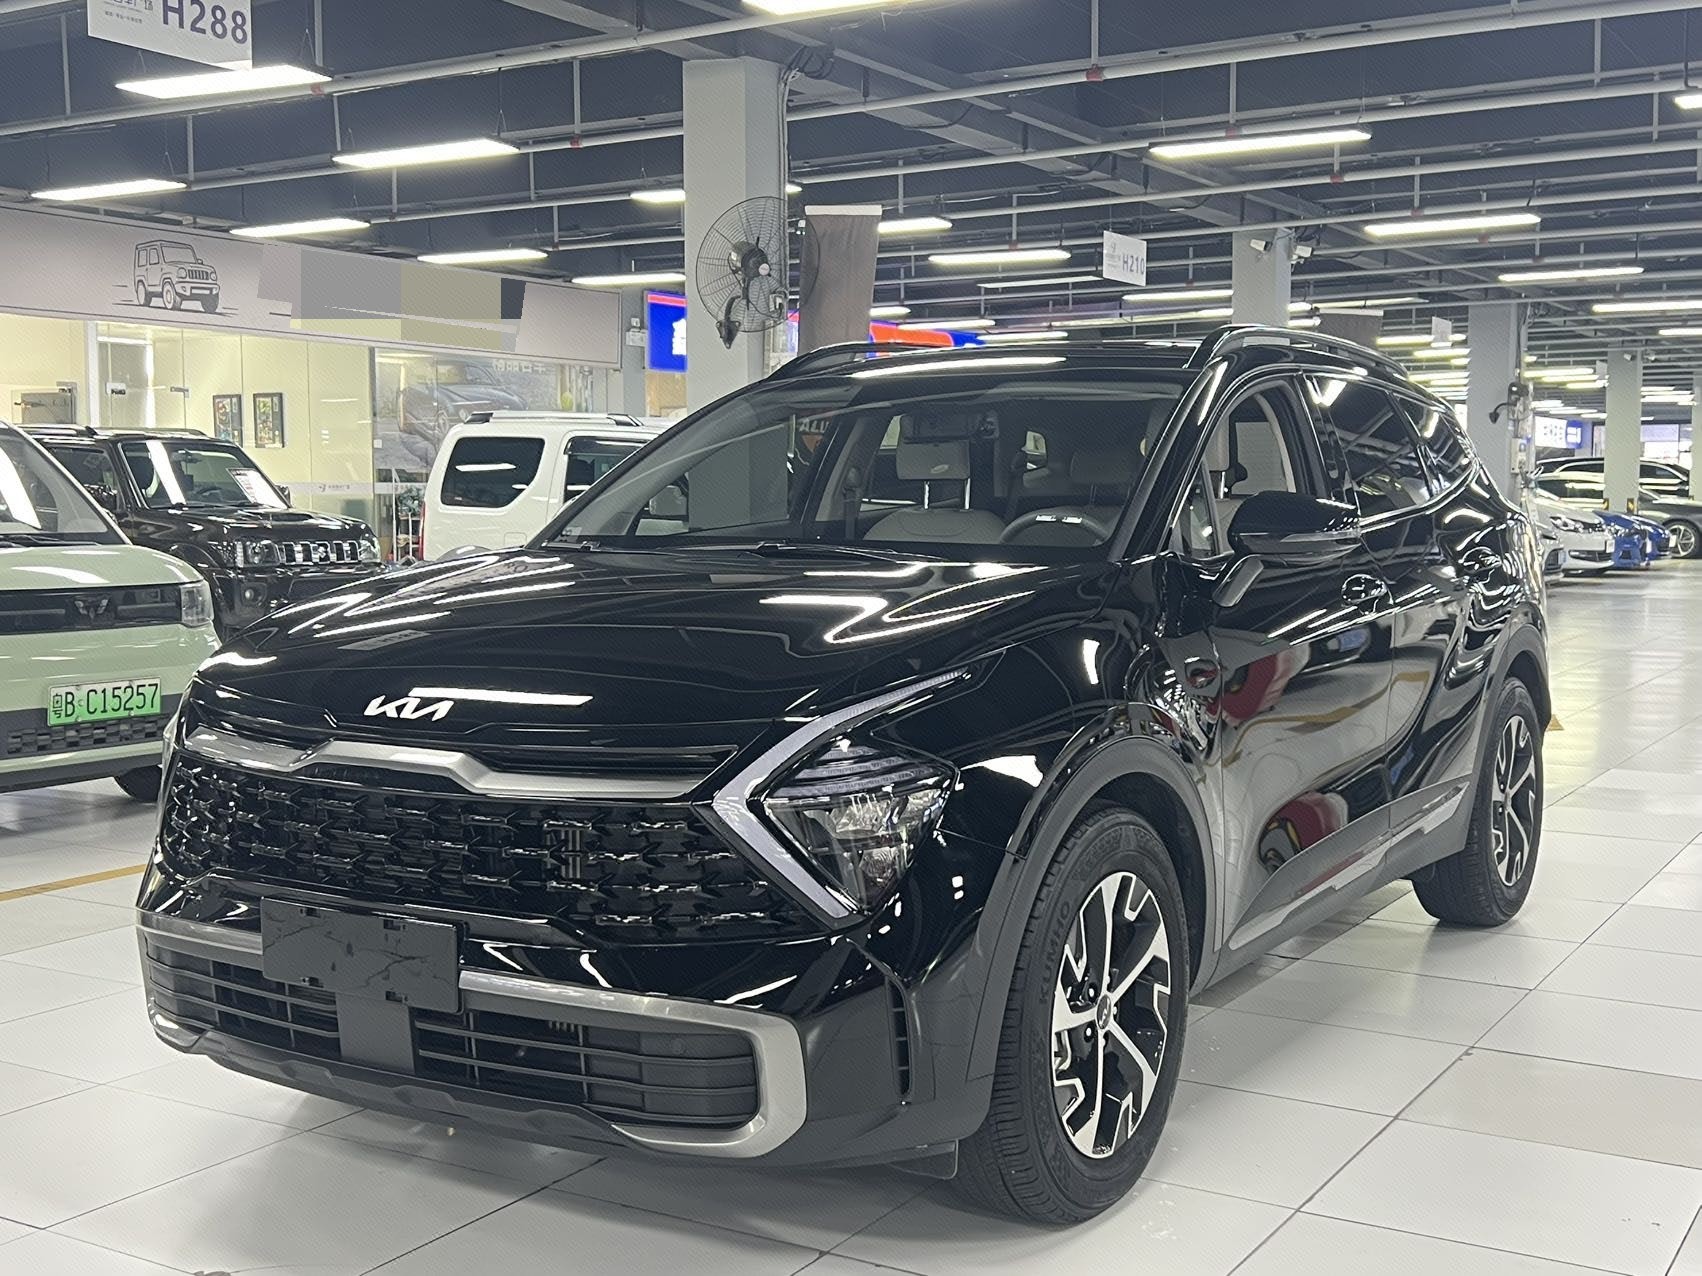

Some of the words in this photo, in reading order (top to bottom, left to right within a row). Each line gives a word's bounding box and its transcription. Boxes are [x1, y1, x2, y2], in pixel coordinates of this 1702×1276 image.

[162, 0, 248, 44] H288
[1122, 253, 1145, 275] H210
[363, 694, 454, 722] KIA
